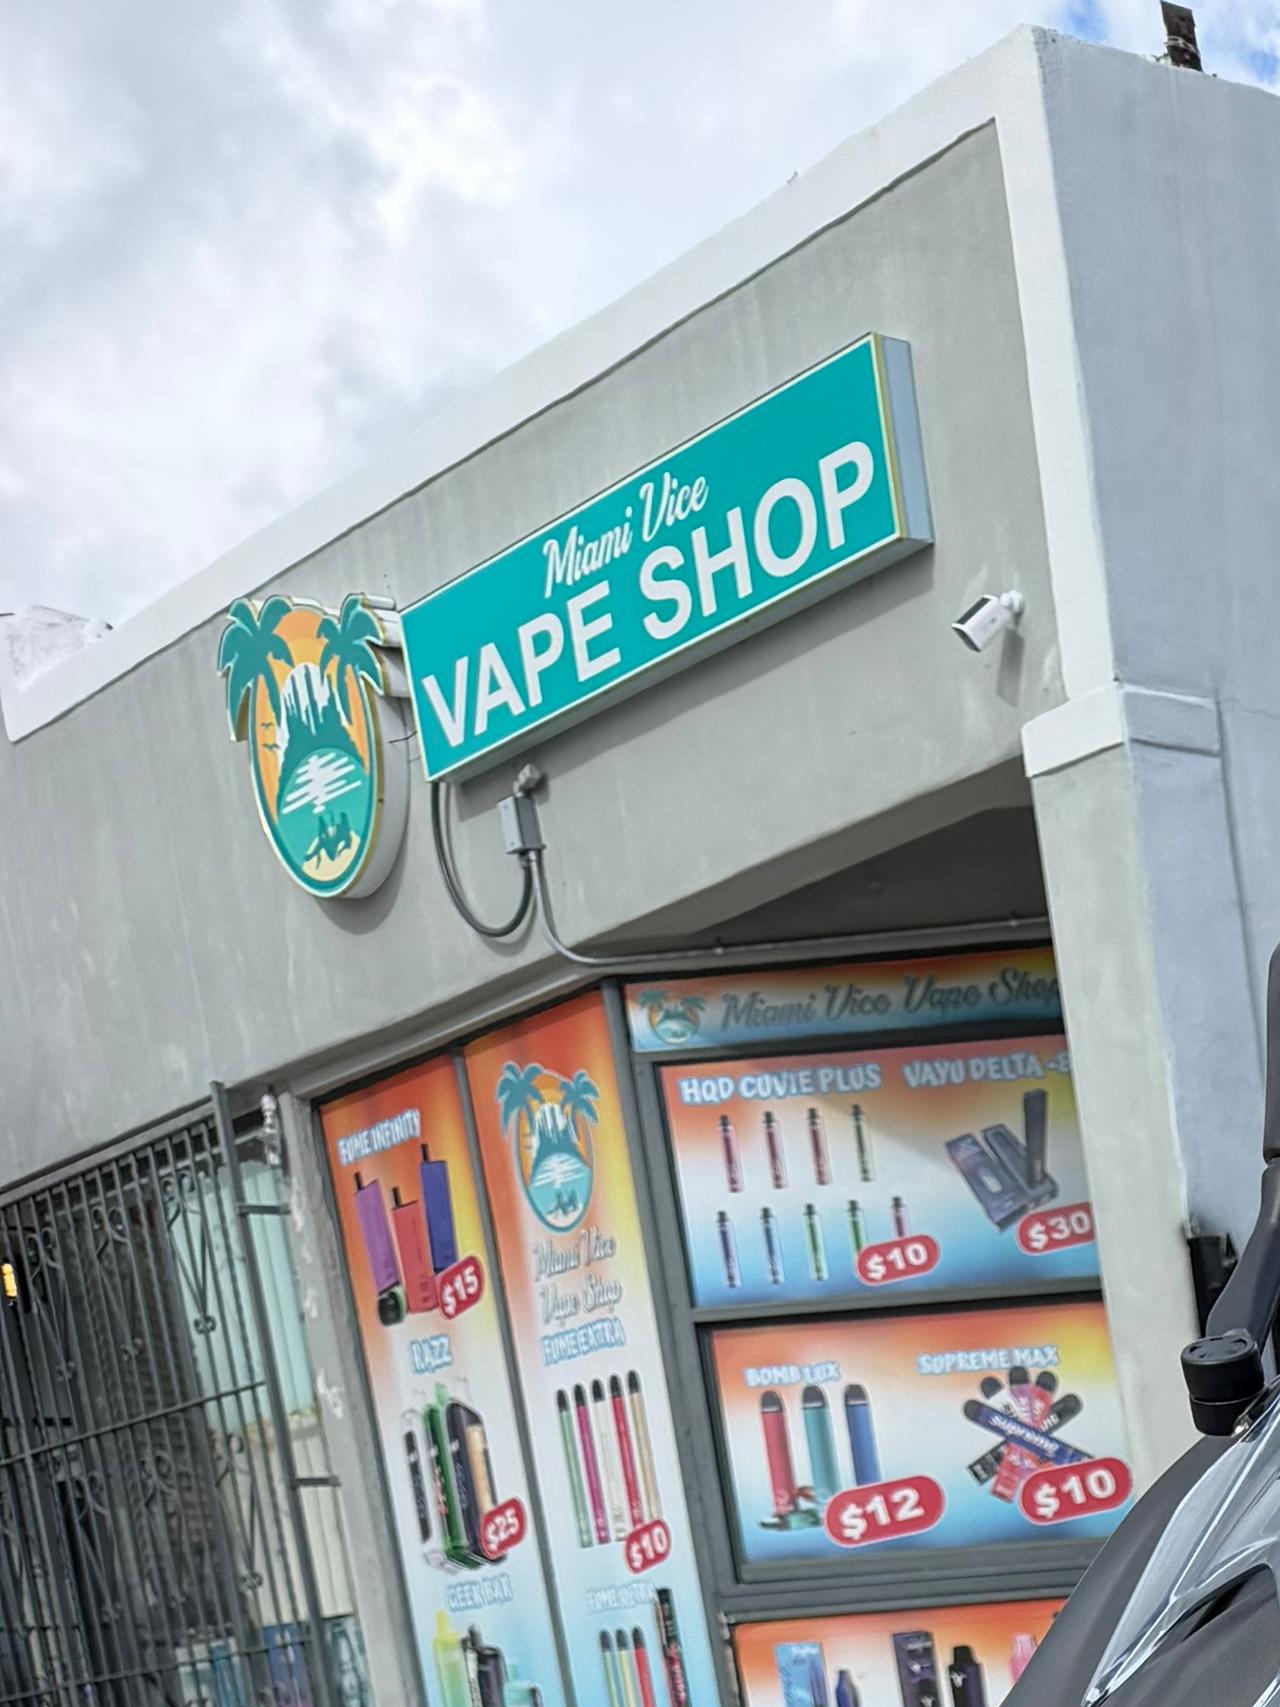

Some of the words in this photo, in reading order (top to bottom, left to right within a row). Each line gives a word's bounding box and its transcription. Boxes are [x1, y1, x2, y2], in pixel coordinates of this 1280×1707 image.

[543, 505, 633, 598] Miami
[639, 471, 710, 543] Vice
[422, 578, 622, 748] VAPE
[638, 440, 875, 642] SHOP
[719, 991, 815, 1032] Miami
[680, 1076, 734, 1105] HQD
[740, 1071, 815, 1099] CUVIE
[817, 1062, 882, 1094] PLUS
[968, 1051, 1044, 1082] DELTA
[1026, 1212, 1091, 1249] $30
[864, 1244, 928, 1281] $10
[441, 1264, 479, 1318] $15
[408, 1334, 453, 1376] RAZZ
[801, 1360, 842, 1385] LUX
[917, 1348, 1011, 1375] SUPREME
[1011, 1344, 1061, 1368] MAX
[838, 1488, 926, 1541] $12
[1032, 1468, 1117, 1519] $10
[484, 1507, 521, 1552] $25
[629, 1527, 669, 1570] $10
